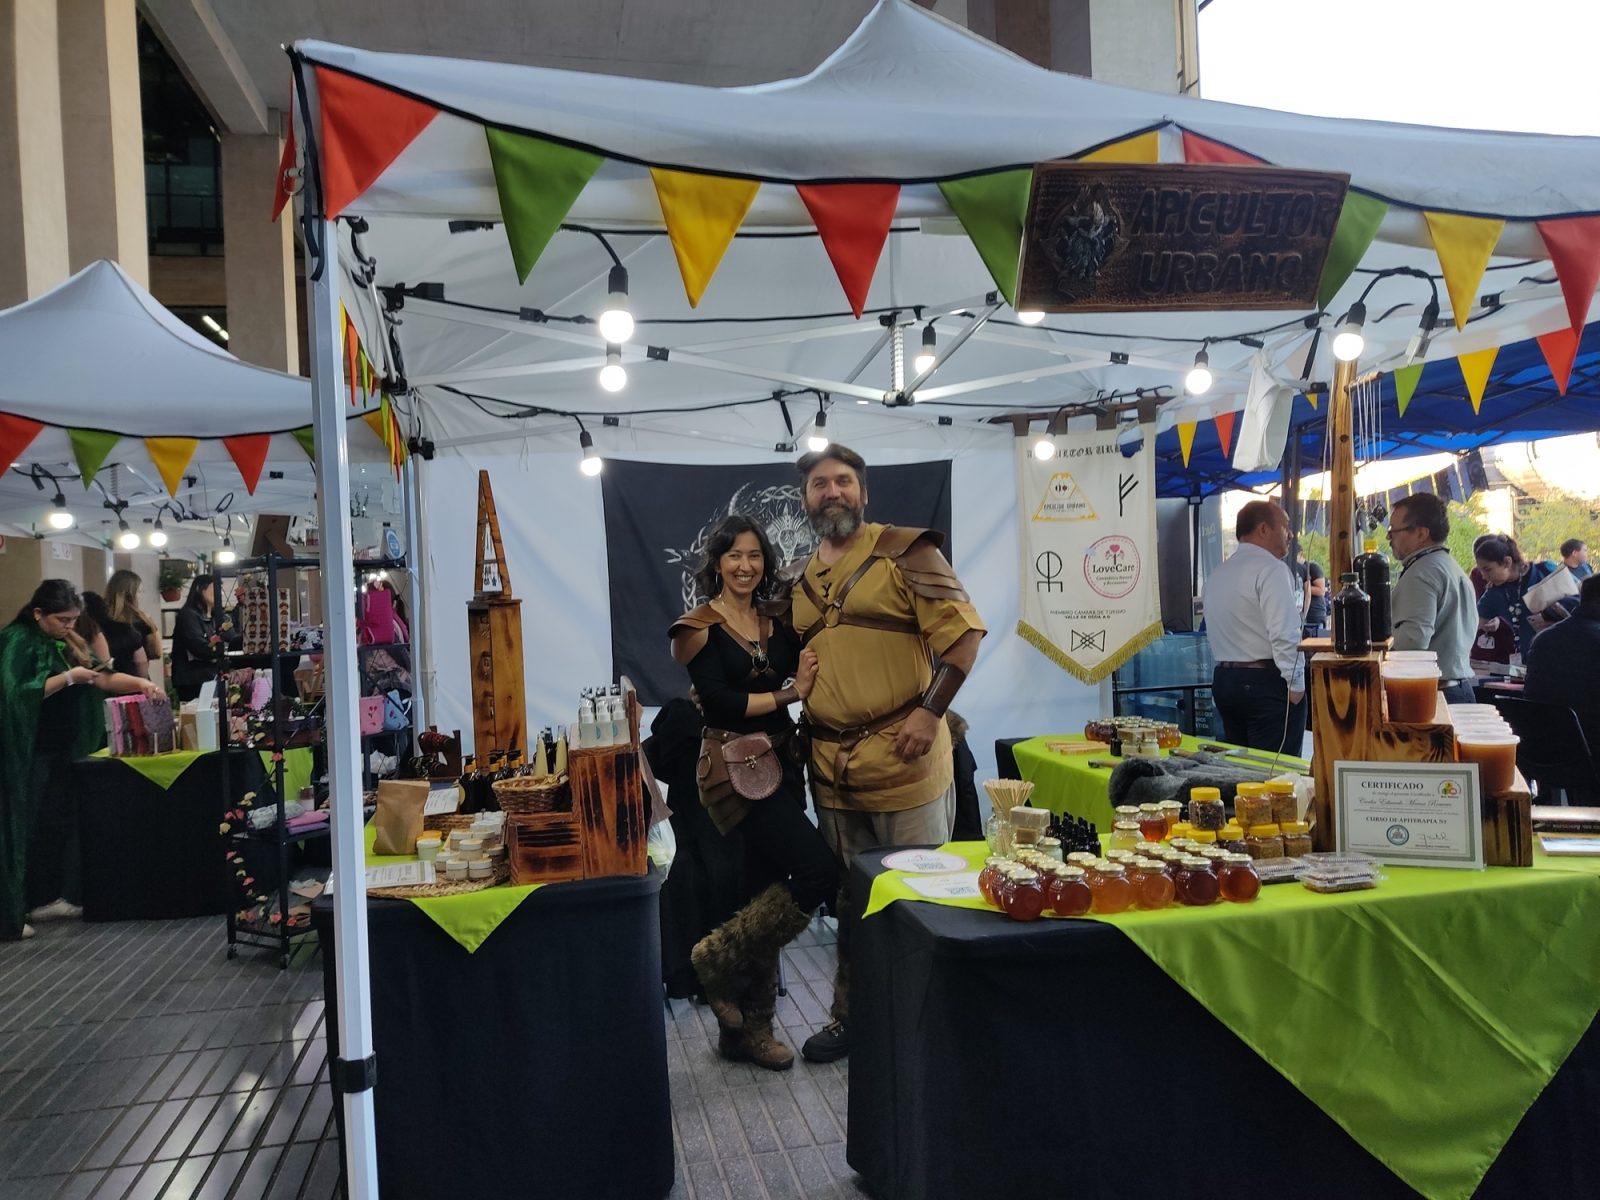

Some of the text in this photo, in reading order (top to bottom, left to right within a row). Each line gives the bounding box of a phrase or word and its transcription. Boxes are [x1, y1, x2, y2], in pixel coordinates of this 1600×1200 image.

[1131, 188, 1339, 238] APICULTOR
[1137, 251, 1304, 294] URBANO
[1093, 563, 1135, 573] LoveCare
[1361, 781, 1424, 790] CERTIFICADO
